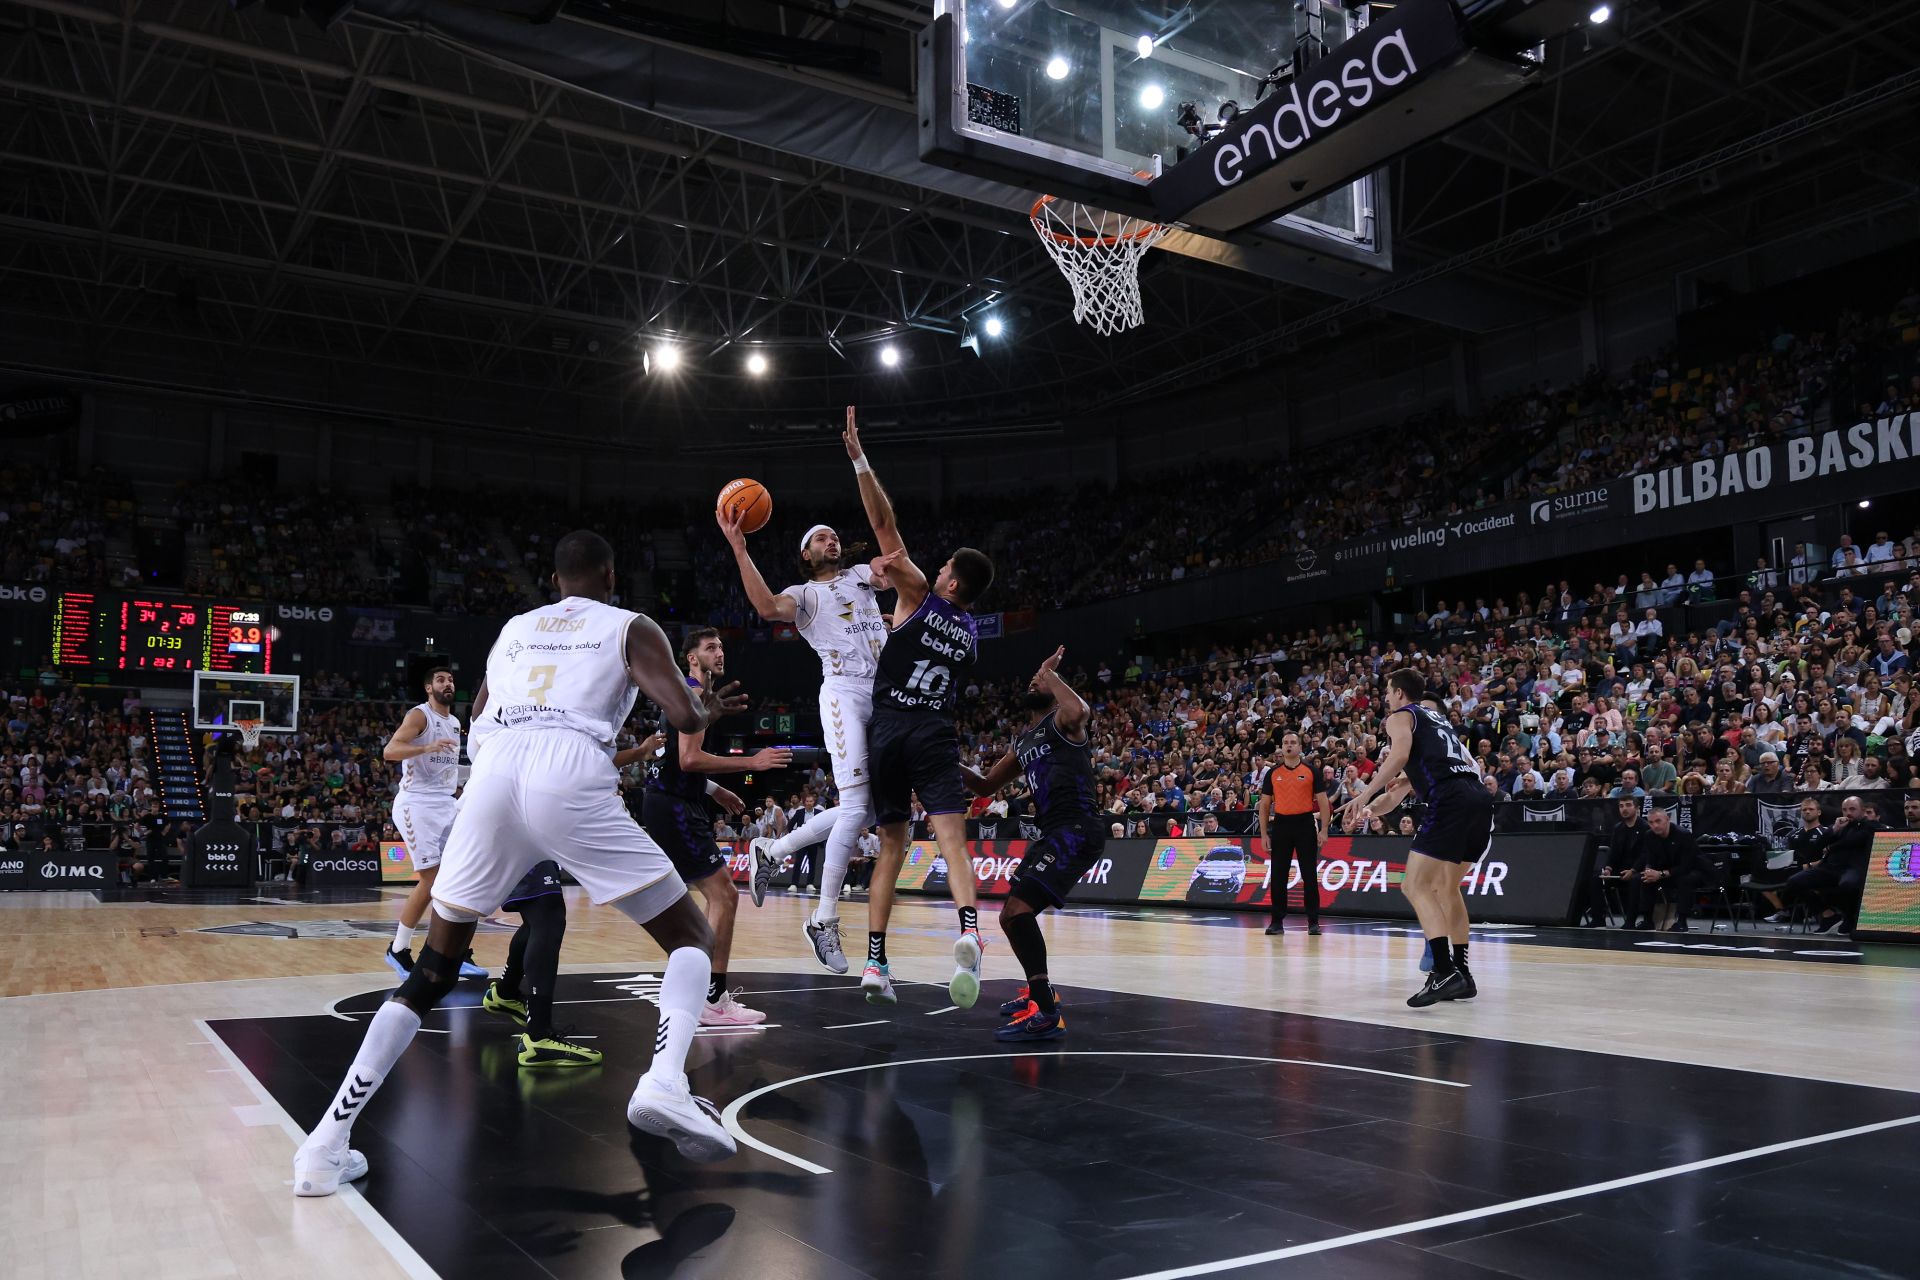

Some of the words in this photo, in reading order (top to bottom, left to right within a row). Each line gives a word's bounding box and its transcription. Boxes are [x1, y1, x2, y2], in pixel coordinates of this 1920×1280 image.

[1214, 28, 1417, 187] endesa
[1633, 446, 1772, 515] BILBAO
[1554, 488, 1608, 511] surne
[1464, 513, 1515, 535] Occident
[1391, 526, 1446, 550] vueling
[140, 609, 156, 621] 34
[179, 612, 195, 625] 28
[232, 612, 260, 622] 07:33
[147, 636, 182, 649] 07:33
[230, 627, 260, 643] 3.9
[527, 642, 572, 650] recoletas
[575, 641, 601, 650] salud
[921, 631, 954, 657] bbk
[905, 660, 950, 697] 10
[60, 865, 104, 879] IMQ
[312, 857, 378, 872] endesa
